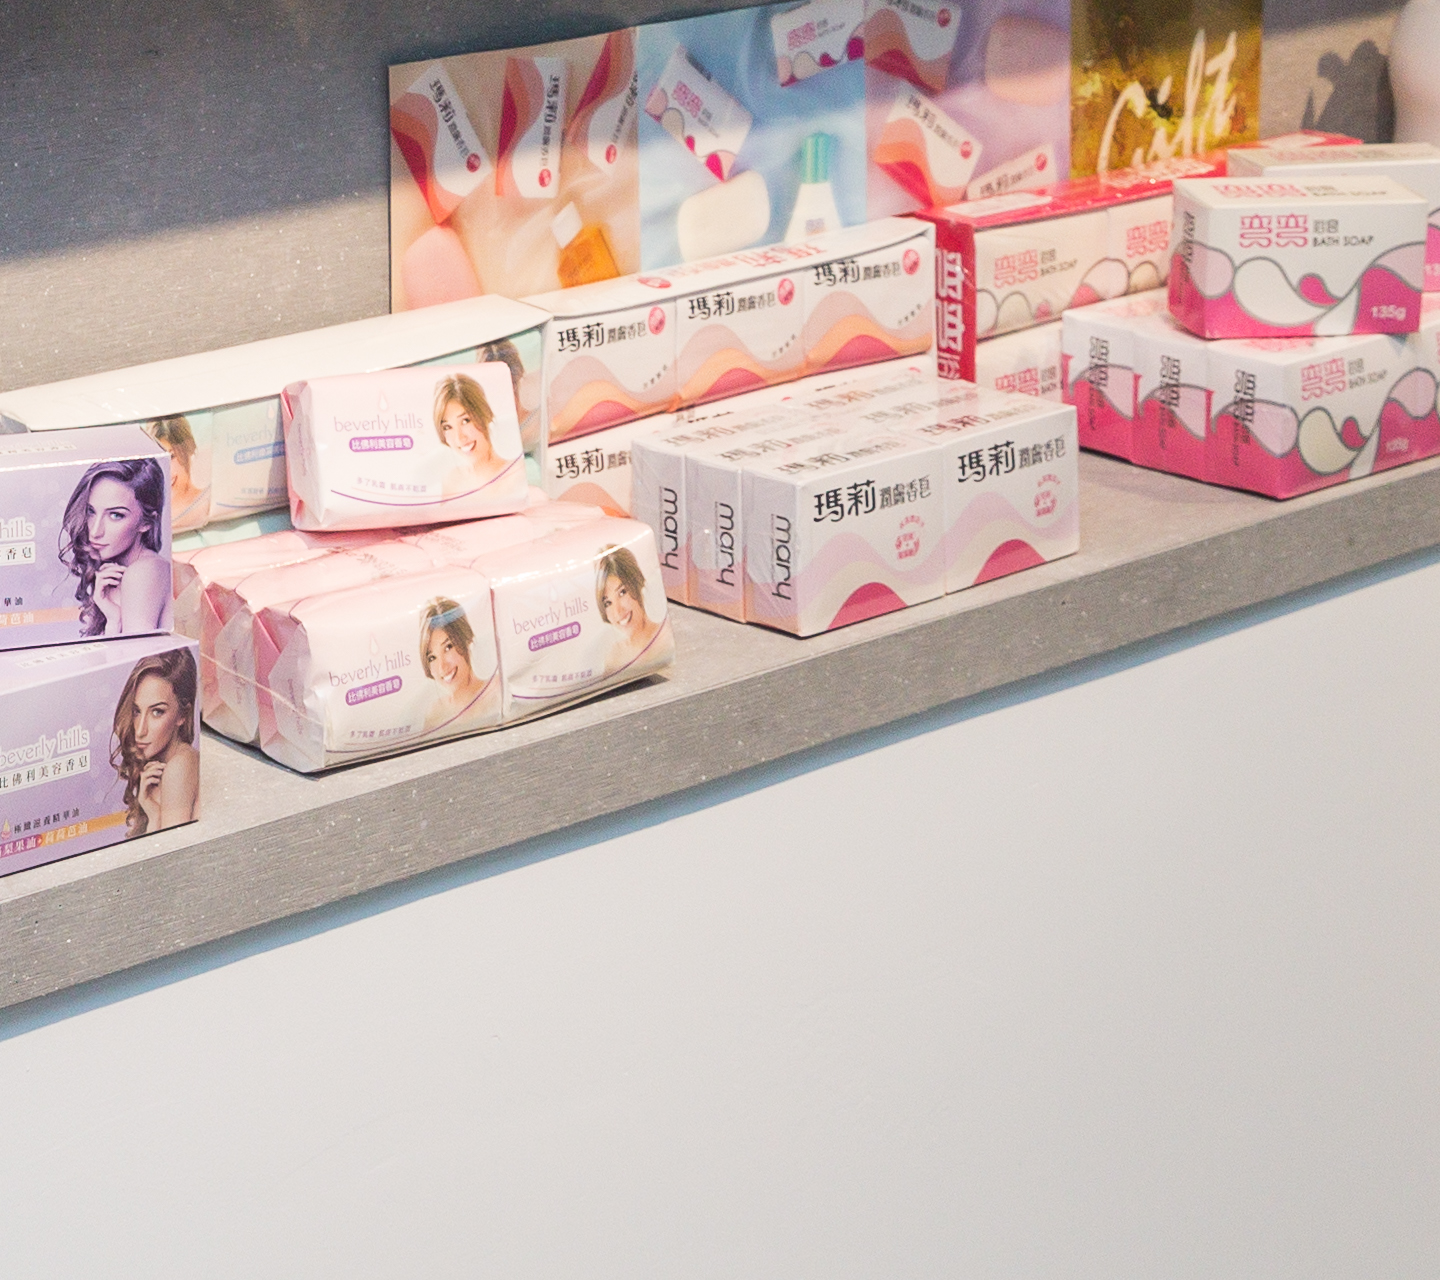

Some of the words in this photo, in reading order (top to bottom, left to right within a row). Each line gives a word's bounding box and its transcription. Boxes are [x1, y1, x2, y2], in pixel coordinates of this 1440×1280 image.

[813, 259, 860, 287] 瑪莉
[688, 292, 734, 320] 瑪莉
[333, 414, 392, 436] beverly
[396, 411, 425, 431] hills
[661, 487, 679, 572] mary
[772, 515, 792, 601] mary
[329, 658, 382, 687] beverly
[385, 650, 411, 669] hills
